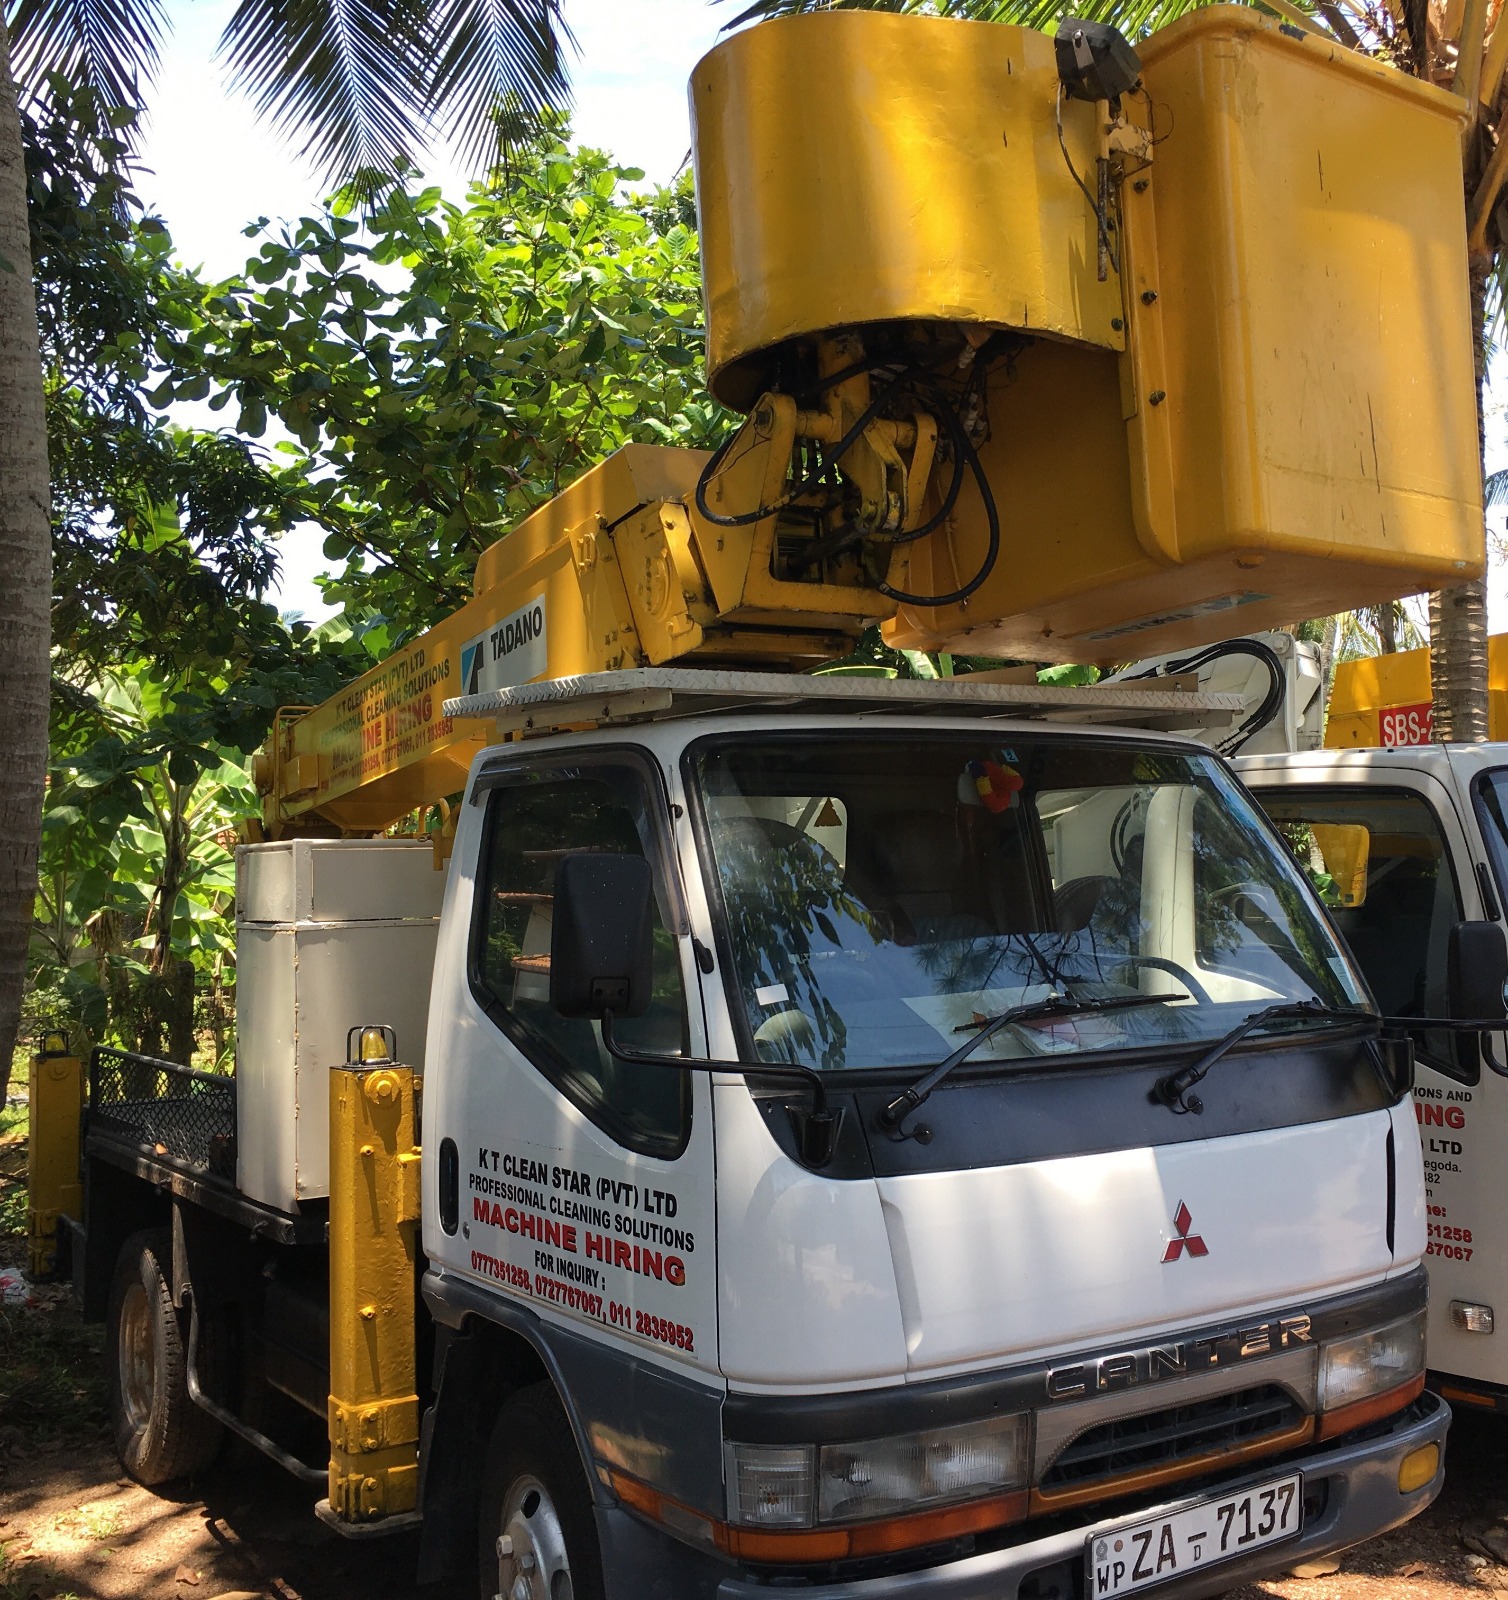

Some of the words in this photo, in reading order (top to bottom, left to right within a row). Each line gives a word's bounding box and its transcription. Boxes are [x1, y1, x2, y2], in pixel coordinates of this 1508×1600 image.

[491, 606, 543, 661] TADANO
[366, 689, 401, 723] CLEANING
[403, 658, 450, 700] SOLUTIONS
[369, 675, 388, 698] STAR
[389, 660, 409, 690] (PVT)
[410, 649, 425, 673] LTD
[385, 693, 432, 741] HIRING
[1412, 1087, 1443, 1099] IONS
[1446, 1090, 1472, 1102] AND
[1424, 1160, 1462, 1173] egoda.
[1430, 1139, 1463, 1155] LTD
[479, 1148, 489, 1169] K
[491, 1151, 500, 1172] T
[503, 1154, 548, 1185] CLEAN
[552, 1167, 591, 1197] STAR
[596, 1177, 639, 1209] (PVT)
[644, 1188, 678, 1218] LTD
[1424, 1172, 1440, 1184] 82
[469, 1173, 547, 1211] PROFESSIONAL
[550, 1196, 611, 1229] CLEANING
[614, 1213, 695, 1252] SOLUTIONS
[473, 1197, 577, 1254] MACHINE
[585, 1231, 685, 1286] HIRING
[1426, 1241, 1473, 1261] 67067
[534, 1250, 554, 1272] FOR
[556, 1258, 599, 1288] INQUIRY
[471, 1250, 533, 1296] 0777351258,
[535, 1274, 606, 1324] 0727767067,
[609, 1300, 632, 1329] 011
[636, 1310, 694, 1352] 2835952
[1048, 1314, 1313, 1399] CANTER
[1097, 1561, 1125, 1594] WP
[1194, 1545, 1201, 1562] D
